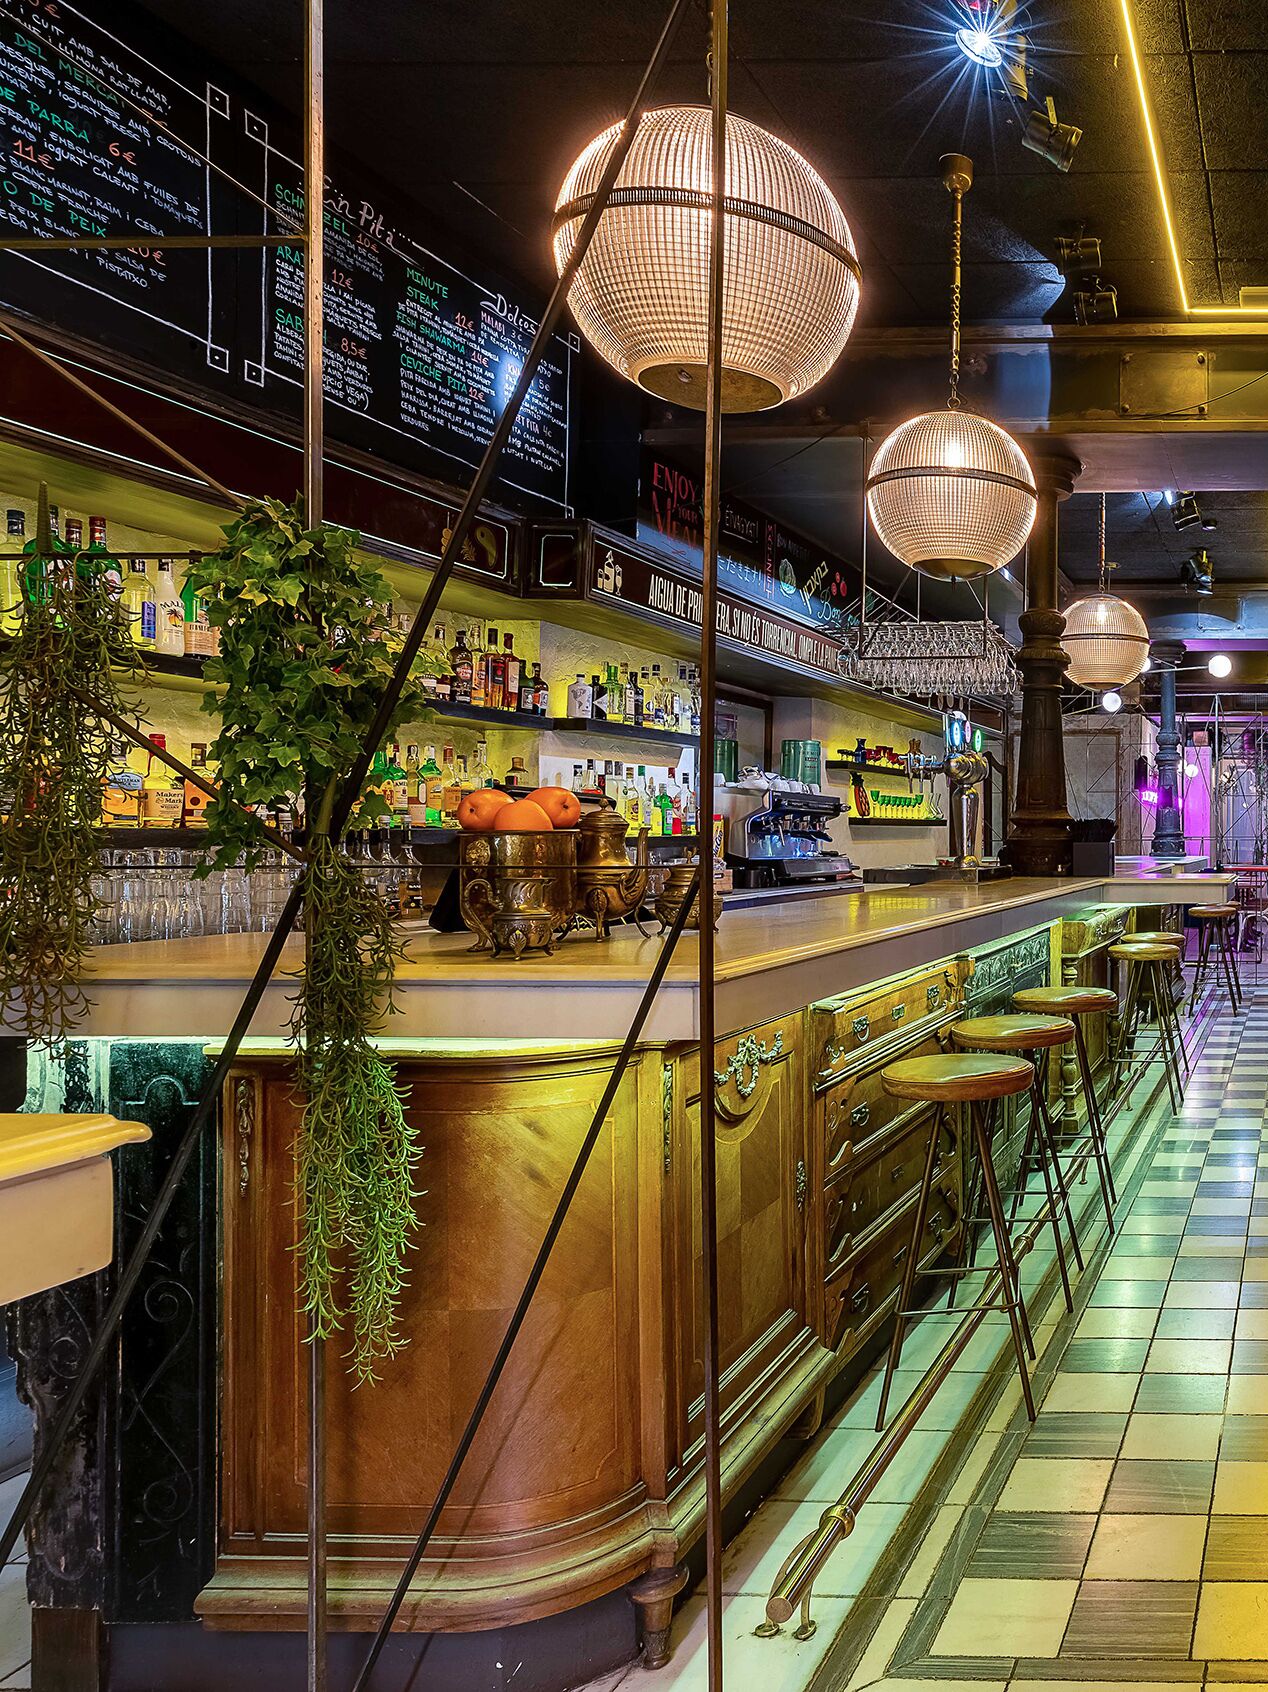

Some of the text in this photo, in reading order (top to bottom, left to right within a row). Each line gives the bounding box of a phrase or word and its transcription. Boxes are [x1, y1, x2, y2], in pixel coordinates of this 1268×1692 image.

[13, 32, 47, 62] DEL
[31, 13, 65, 36] CUIT
[68, 37, 94, 58] AMB
[99, 55, 123, 76] SAL
[125, 72, 143, 88] DE
[145, 85, 172, 110] MAR,
[57, 42, 105, 77] LLIMONA
[109, 75, 167, 115] RATLLADA.
[27, 99, 90, 143] PARRA
[63, 80, 120, 120] SERVIDES
[127, 118, 151, 138] AMB
[155, 135, 201, 167] CROTONS
[103, 115, 141, 142] FRESC
[10, 124, 37, 142] AMB
[92, 166, 139, 194] CALENT
[49, 131, 113, 169] EMBOLICAT
[116, 165, 139, 184] AMB
[183, 200, 200, 216] DE
[8, 154, 46, 182] BLANC
[134, 217, 164, 237] CEBA
[29, 191, 107, 239] DE PEIX
[7, 198, 39, 222] PEIX
[114, 251, 145, 272] SALSA
[148, 267, 167, 282] DE
[359, 200, 398, 247] Pita
[331, 268, 354, 291] 12€
[406, 266, 449, 299] MINUTE
[406, 285, 475, 336] STEAK 12€
[395, 309, 490, 369] FISH SHAWARMA 14€
[399, 353, 442, 382] CEVICHE
[446, 375, 468, 394] PITA
[468, 386, 486, 403] 12€
[653, 462, 698, 508] ENJOY
[648, 573, 674, 614] AIGUA
[675, 584, 688, 618] DE
[740, 610, 752, 641] NO
[751, 611, 761, 645] ÉS
[799, 634, 817, 665] OMPLE
[817, 643, 826, 668] LA
